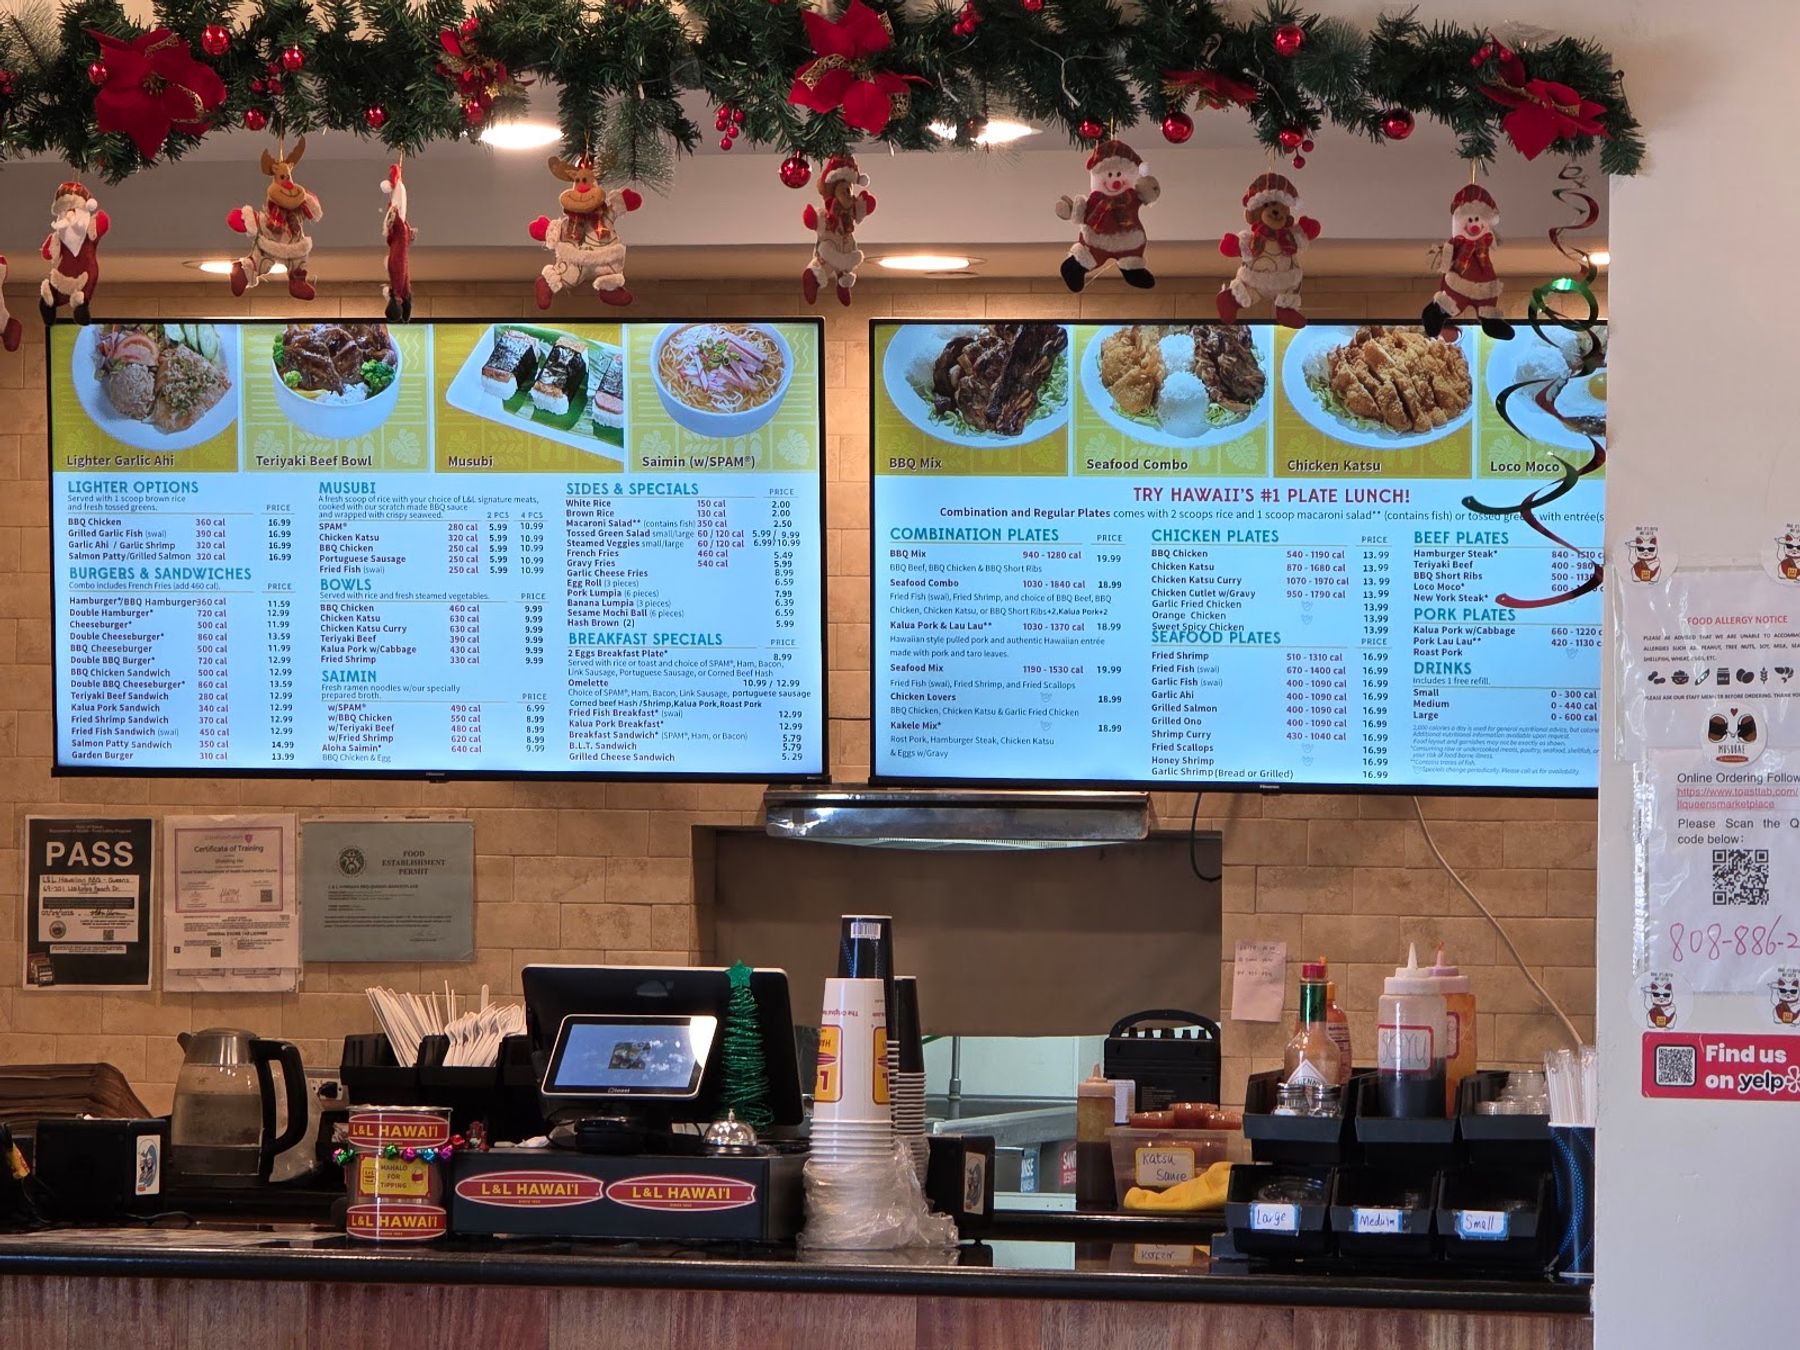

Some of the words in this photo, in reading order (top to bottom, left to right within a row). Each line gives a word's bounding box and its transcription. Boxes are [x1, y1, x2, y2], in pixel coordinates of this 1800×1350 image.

[65, 455, 110, 468] Lighter
[115, 455, 151, 466] Garlic
[154, 455, 175, 466] Ahi
[256, 456, 305, 468] Teriyaki
[310, 456, 338, 466] Beef
[342, 456, 372, 466] Bowl
[449, 456, 492, 467] Musubi
[643, 456, 685, 466] Saimin
[888, 457, 916, 469] BBQ
[921, 457, 942, 469] Mix
[1087, 459, 1138, 469] Seafood
[1144, 459, 1187, 470] Combo
[1288, 460, 1339, 471] Chicken
[1344, 460, 1381, 472] Katsu
[1491, 462, 1520, 472] Loco
[1526, 461, 1561, 472] Moco
[67, 481, 127, 494] LIGHTER
[134, 480, 198, 493] OPTIONS
[319, 482, 376, 494] MUSUBI
[567, 483, 608, 495] SIDES
[612, 483, 623, 494] &
[628, 483, 698, 495] SPECIALS
[1134, 488, 1163, 501] TRY
[1172, 488, 1254, 502] HAWAII'S
[1261, 489, 1280, 502] #1
[1288, 489, 1337, 502] PLATE
[1346, 489, 1409, 503] LUNCH!
[566, 499, 590, 508] White
[592, 499, 610, 508] Rice
[698, 500, 712, 508] 150
[714, 500, 726, 508] cal
[772, 500, 790, 509] 2.00
[940, 507, 1007, 516] Combination
[1012, 508, 1030, 516] and
[1034, 508, 1075, 519] Regular
[1078, 508, 1110, 517] Plates
[1148, 509, 1168, 518] with
[1180, 511, 1212, 520] scoops
[1216, 510, 1233, 518] rice
[1236, 510, 1255, 518] and
[1265, 512, 1294, 521] scoop
[1298, 510, 1343, 519] macaroni
[1385, 511, 1428, 520] (contains
[1432, 511, 1453, 520] fish)
[1469, 512, 1500, 520] tossed
[1540, 512, 1561, 520] with
[68, 518, 86, 527] BBQ
[88, 518, 122, 526] Chicken
[889, 528, 1000, 541] COMBINATION
[1008, 529, 1058, 541] PLATES
[1097, 534, 1123, 542] PRICE
[1152, 529, 1220, 542] CHICKEN
[1228, 530, 1278, 542] PLATES
[1415, 532, 1449, 545] BEEF
[1457, 532, 1508, 544] PLATES
[320, 555, 368, 564] Portuguese
[371, 555, 405, 564] Sausage
[489, 555, 507, 564] 5.99
[68, 567, 134, 581] BURGERS
[140, 568, 148, 580] &
[153, 568, 251, 581] SANDWICHES
[320, 579, 372, 591] BOWLS
[1415, 608, 1456, 620] PORK
[1464, 607, 1517, 621] PLATES
[1715, 617, 1752, 625] ALLERGY
[1756, 616, 1788, 624] NOTICE
[570, 633, 647, 646] BREAKFAST
[653, 633, 722, 645] SPECIALS
[1152, 631, 1222, 643] SEAFOOD
[1230, 632, 1280, 644] PLATES
[370, 645, 416, 654] w/Cabbage
[1414, 662, 1471, 674] DRINKS
[322, 670, 376, 682] SAIMIN
[568, 679, 609, 687] Omelette
[71, 692, 104, 700] Teriyaki
[1413, 711, 1438, 720] Large
[1152, 730, 1183, 739] Shrimp
[1186, 731, 1211, 740] Curry
[1363, 733, 1388, 742] 16.99
[1678, 773, 1712, 783] Online
[1716, 773, 1763, 785] Ordering
[1678, 819, 1715, 828] Please
[1726, 818, 1753, 828] Scan
[1763, 819, 1780, 828] the
[1678, 834, 1704, 844] code
[1708, 834, 1744, 844] below:
[46, 841, 134, 867] PASS
[238, 845, 264, 853] Training
[1706, 1043, 1754, 1062] Find
[1759, 1049, 1787, 1062] us
[1705, 1075, 1734, 1089] on
[1740, 1072, 1784, 1093] yelp
[352, 1124, 374, 1136] L&L
[381, 1124, 438, 1137] HAWAI'I
[1143, 1154, 1175, 1165] Katsu
[482, 1184, 511, 1196] L&L
[517, 1184, 578, 1196] HAWAI'I
[633, 1186, 662, 1198] L&L
[668, 1187, 731, 1199] HAWAI'I
[351, 1215, 374, 1227] L&L
[380, 1216, 437, 1227] HAWAI'I
[1257, 1209, 1286, 1225] Large
